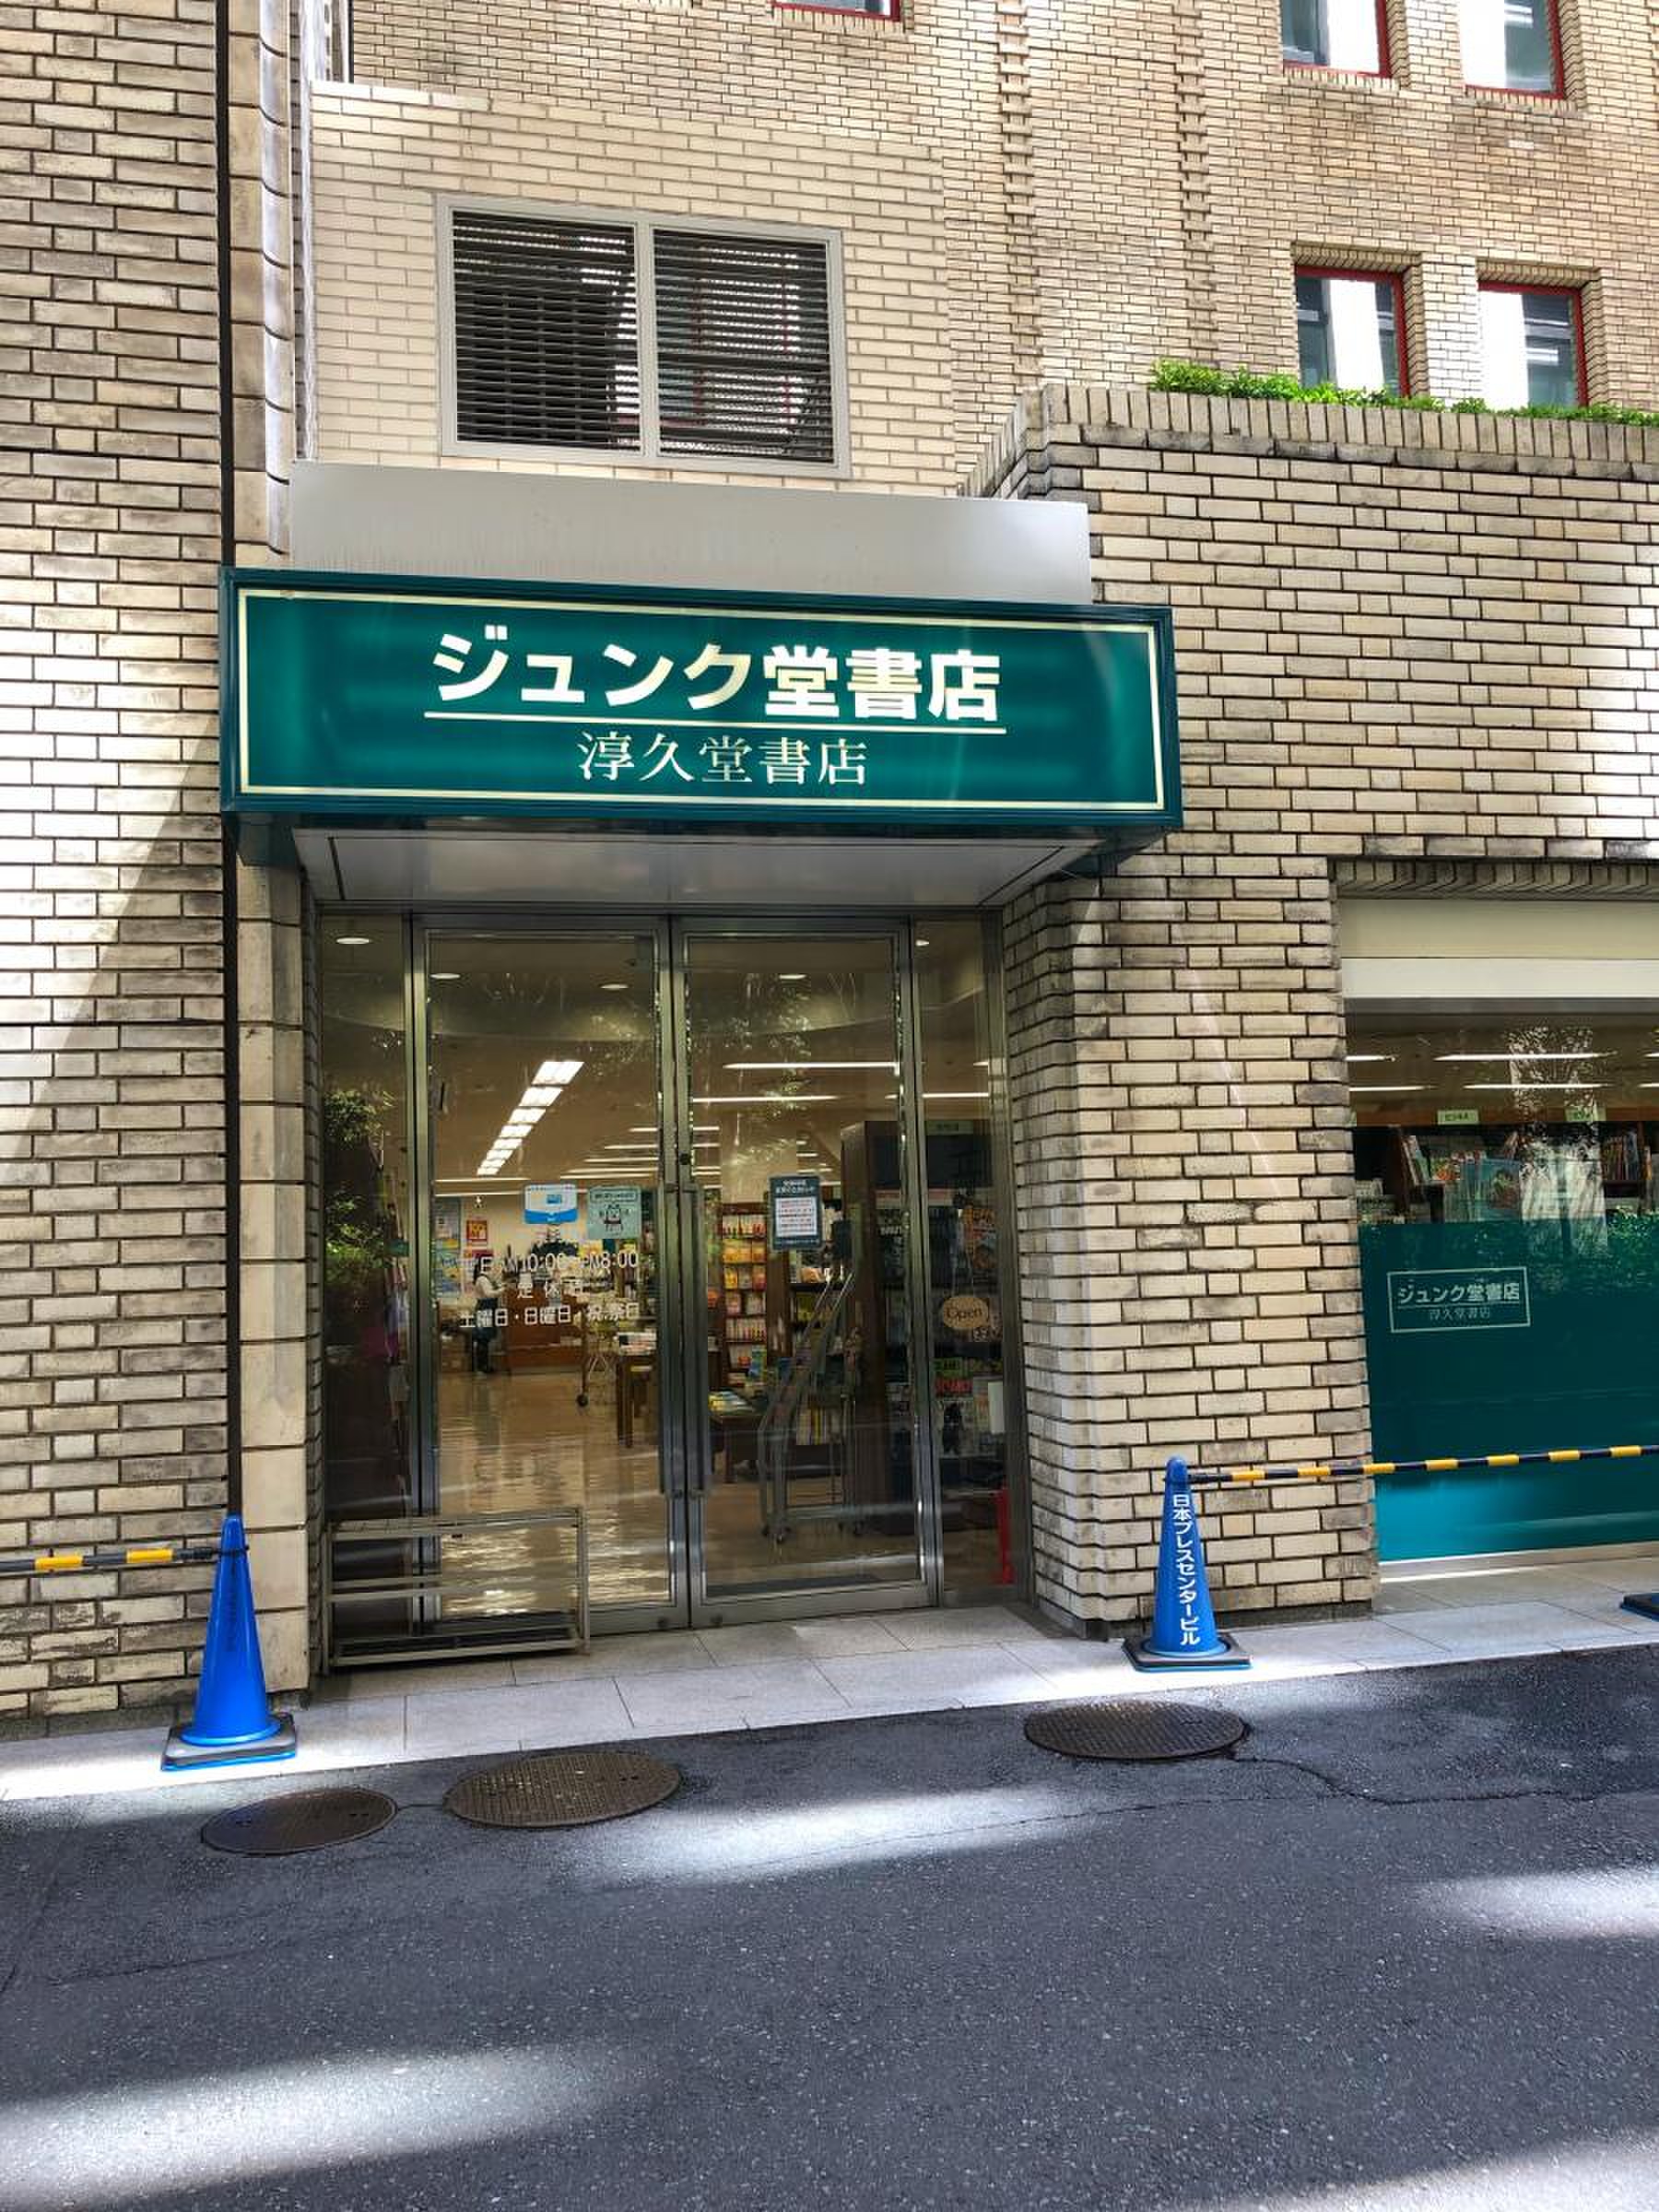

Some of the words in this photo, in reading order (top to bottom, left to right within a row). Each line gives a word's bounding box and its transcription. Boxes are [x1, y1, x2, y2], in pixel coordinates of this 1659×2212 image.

[431, 625, 1002, 722] ジュンク堂書店
[578, 730, 868, 786] 淳久堂書店
[1397, 1280, 1520, 1304] ジュンク堂書店
[1172, 1493, 1201, 1646] 日本プレスセンタービル
